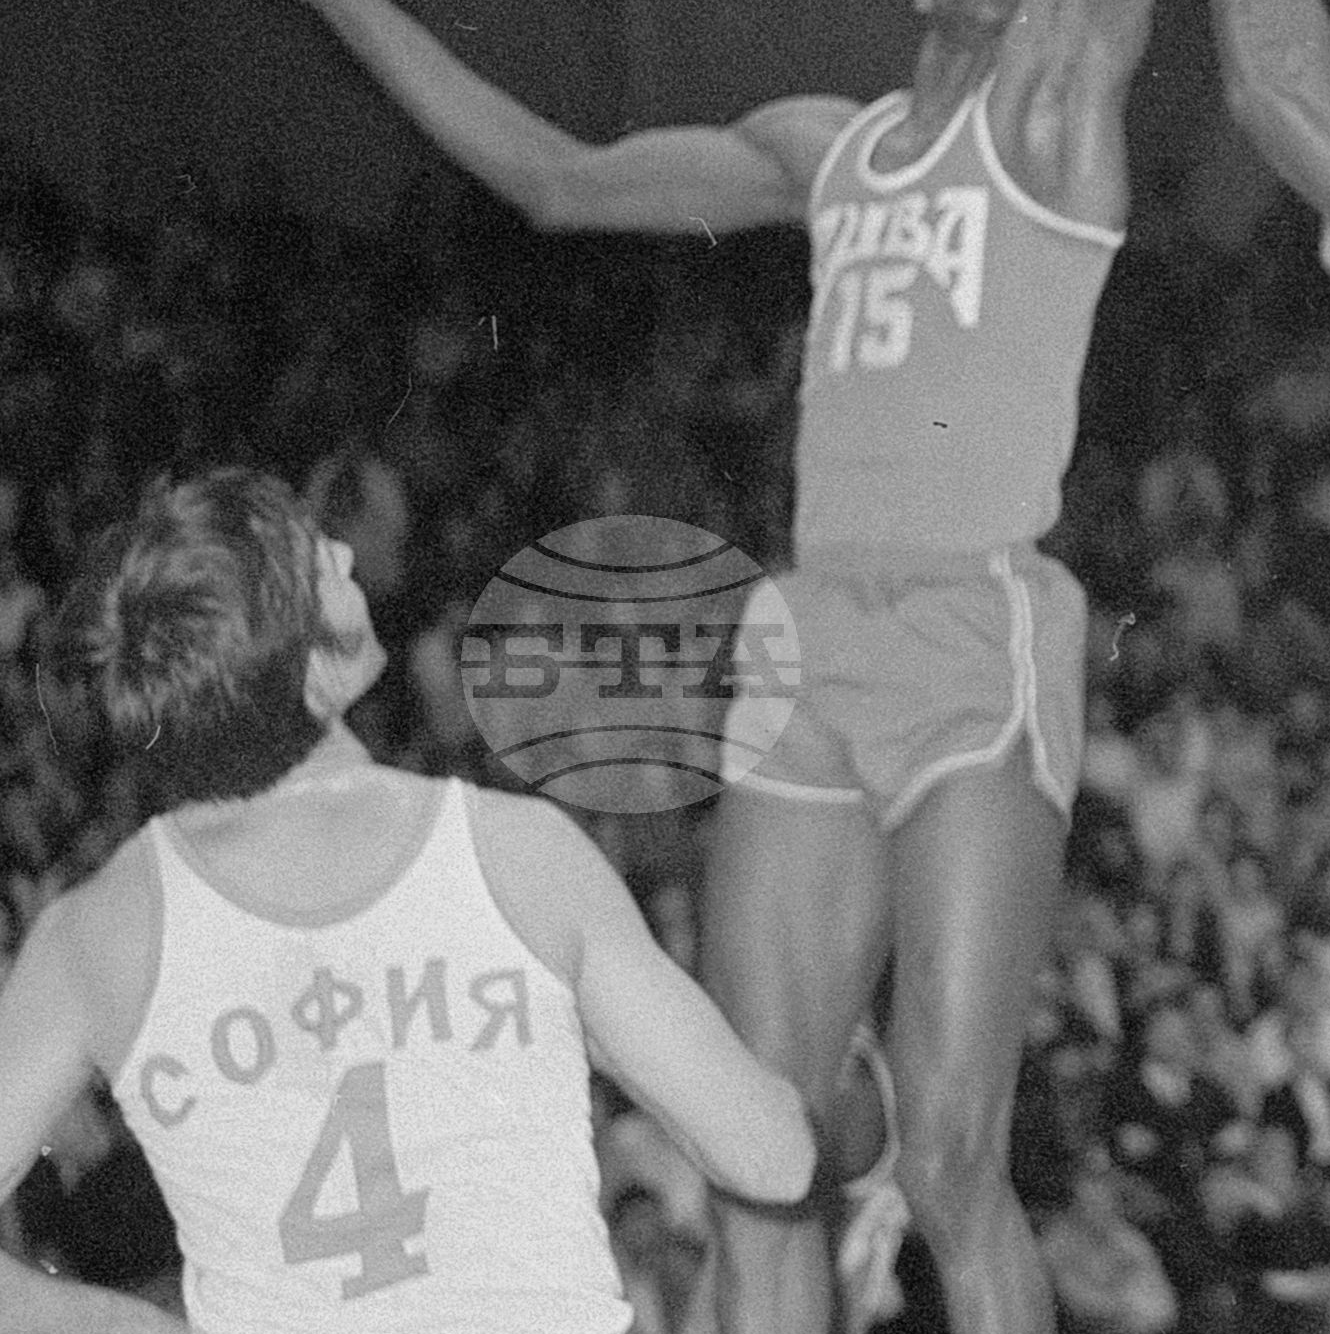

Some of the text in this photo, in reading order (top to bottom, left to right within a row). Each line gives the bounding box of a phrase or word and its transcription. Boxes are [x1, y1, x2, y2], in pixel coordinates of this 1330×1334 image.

[829, 267, 916, 371] 15
[140, 956, 535, 1128] СОФИЯ
[278, 1061, 432, 1302] 4
